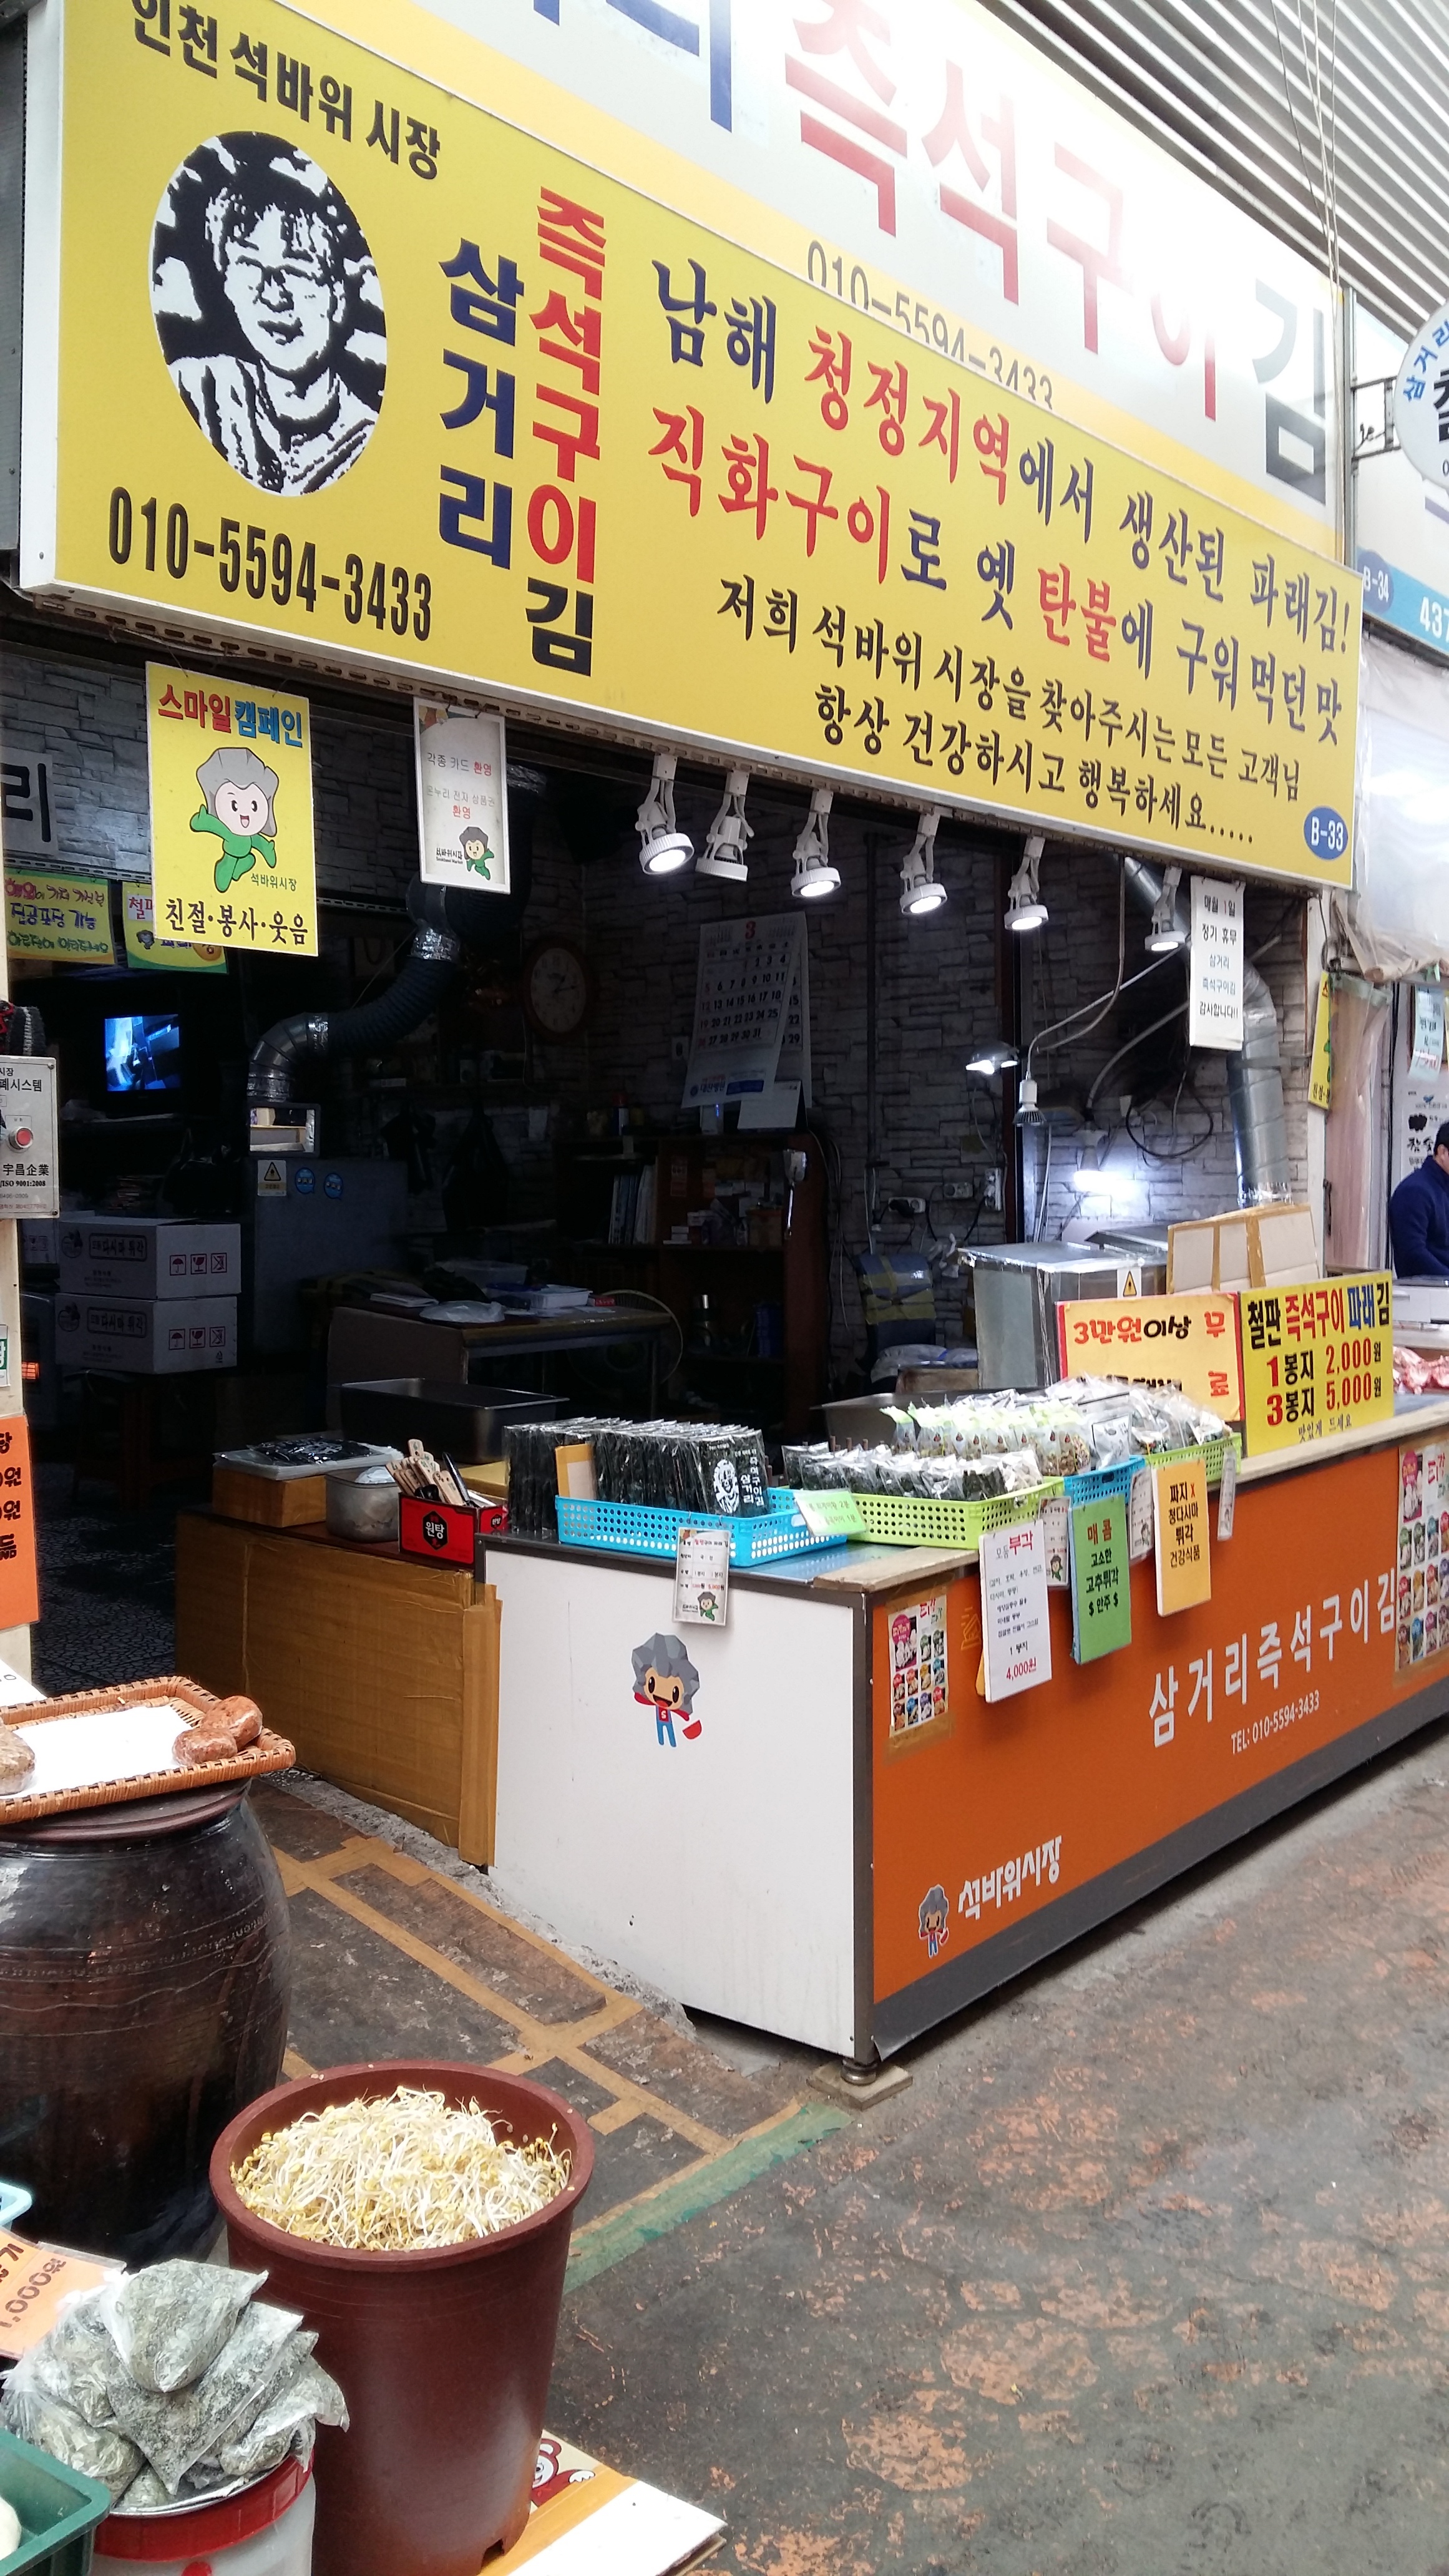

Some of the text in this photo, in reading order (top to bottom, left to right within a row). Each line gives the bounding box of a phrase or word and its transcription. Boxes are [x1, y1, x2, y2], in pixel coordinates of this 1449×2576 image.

[133, 0, 441, 181] 인천 석바위 시장
[437, 237, 525, 571] 삼거리
[524, 185, 605, 678] 즉석구이김
[651, 258, 1350, 654] 남해 청정지역에서 생산된 파래김!
[108, 485, 432, 642] 010-5594-3433
[647, 404, 947, 592] 직화구이로
[977, 539, 1015, 631] 옛
[1037, 562, 1154, 681] 탄불에
[1176, 618, 1238, 712] 구워
[1364, 565, 1389, 603] B-34
[716, 573, 798, 655] 저희
[812, 605, 922, 691] 석바위
[934, 644, 1032, 721] 시장을
[1237, 748, 1300, 803] 고객님
[814, 683, 890, 755] 항상
[903, 709, 1066, 794] 건강하시고
[451, 757, 470, 772] 카드
[251, 872, 297, 892] 석바위시장
[1310, 816, 1344, 852] B-33
[1247, 1297, 1282, 1352] 철판
[1285, 1287, 1345, 1343] 즉석구이
[425, 1521, 445, 1539] 원탕
[958, 1834, 1062, 1921] 석바위시장
